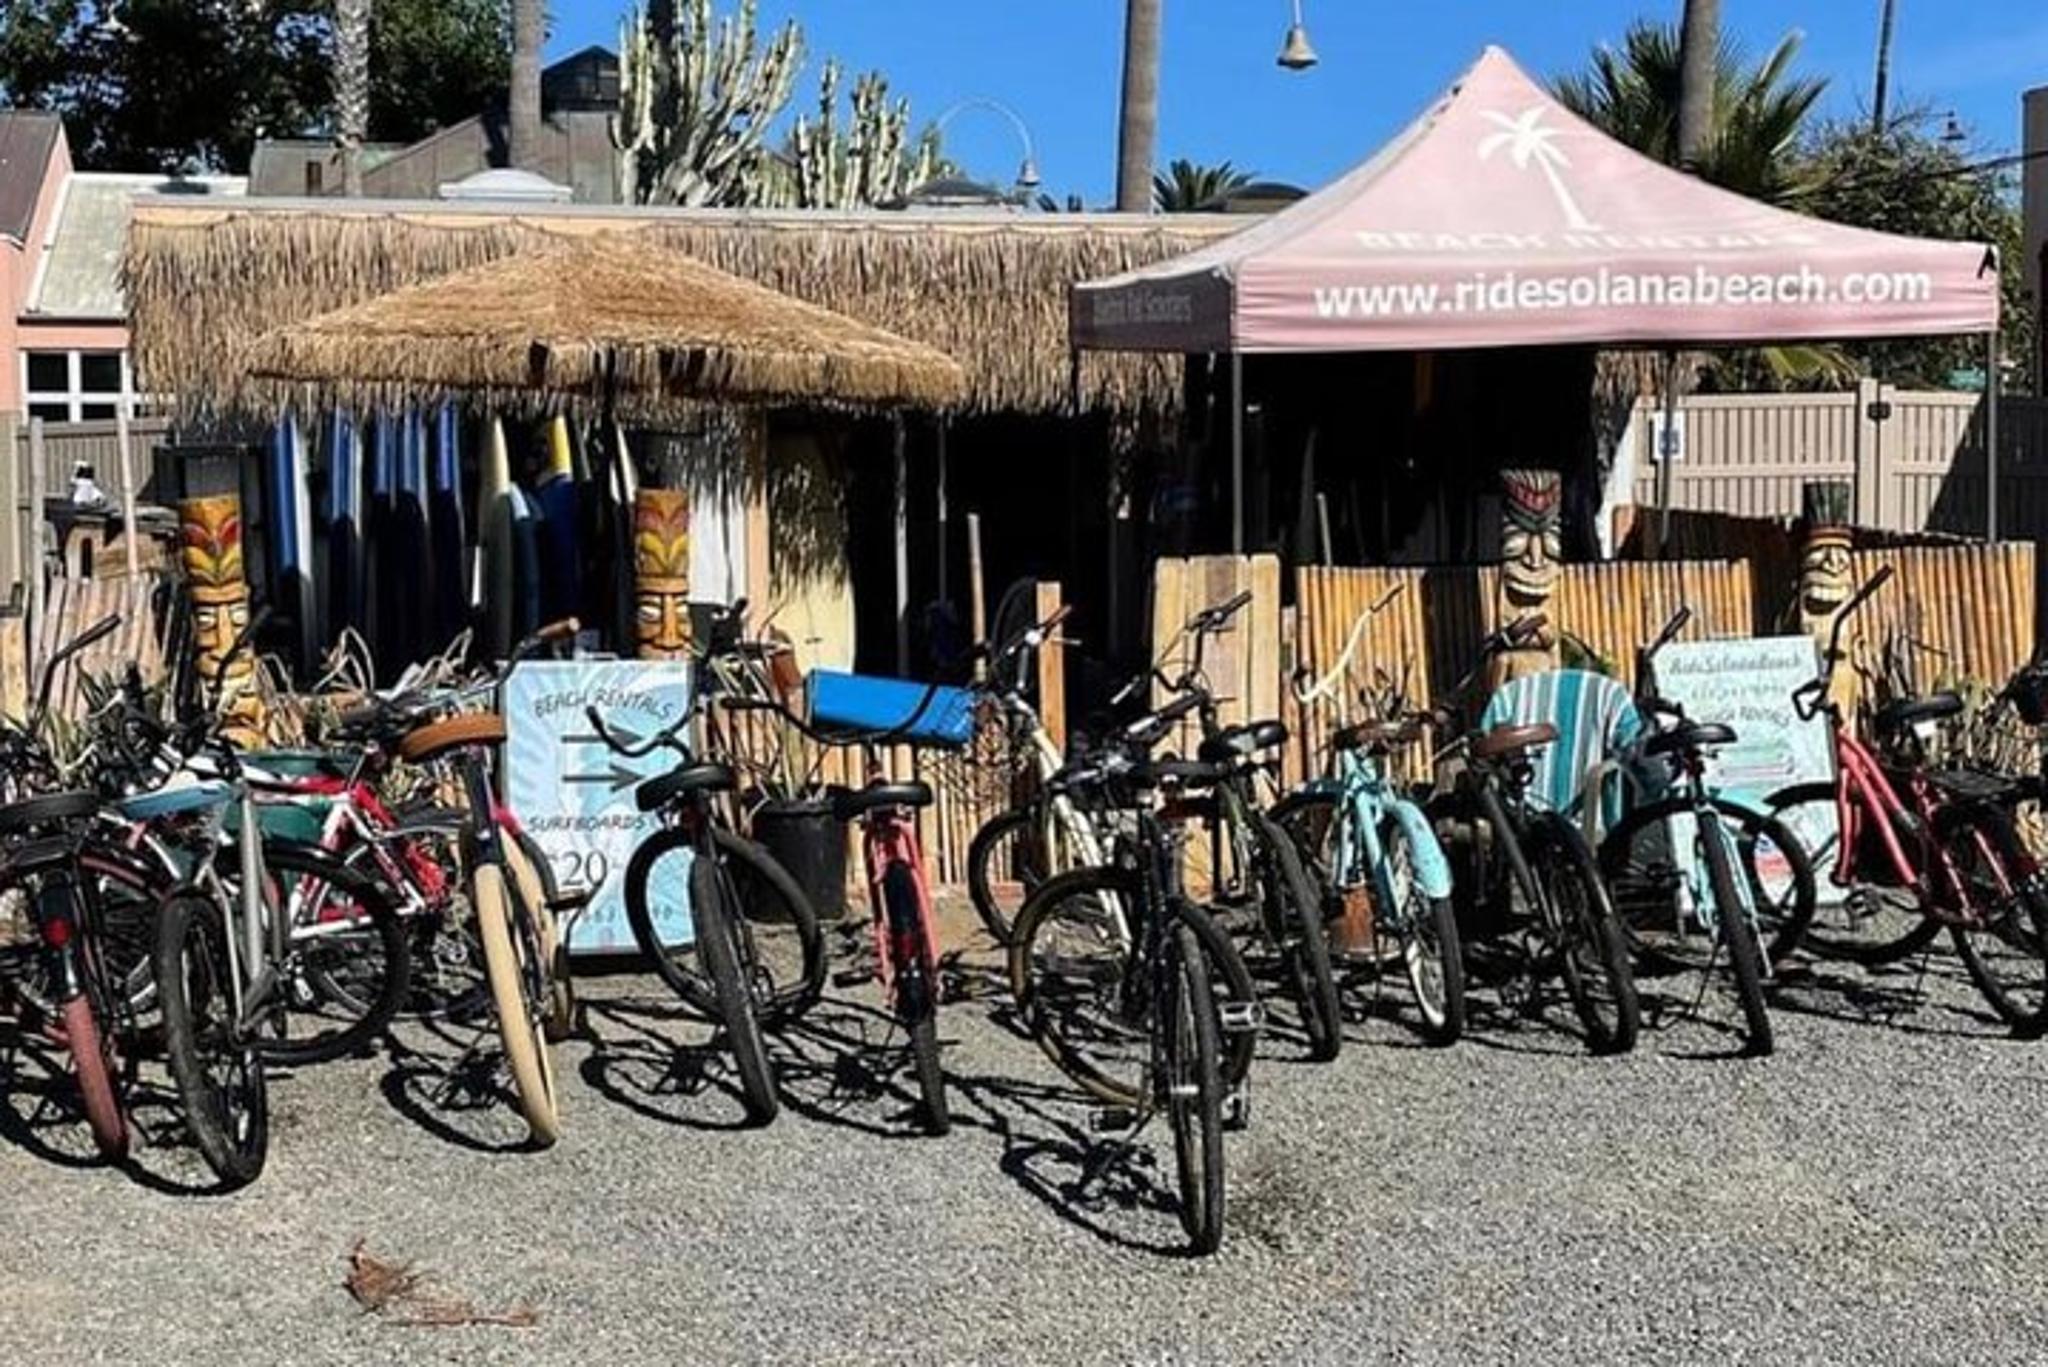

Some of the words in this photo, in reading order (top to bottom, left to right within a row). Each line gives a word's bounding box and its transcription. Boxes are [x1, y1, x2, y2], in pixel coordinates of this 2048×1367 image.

[1315, 266, 1932, 318] www.ridesolanabeach.com
[534, 688, 589, 720] BEACH
[595, 690, 675, 720] RENTALS
[529, 813, 647, 832] SURFBOARDS
[552, 850, 608, 886] 20
